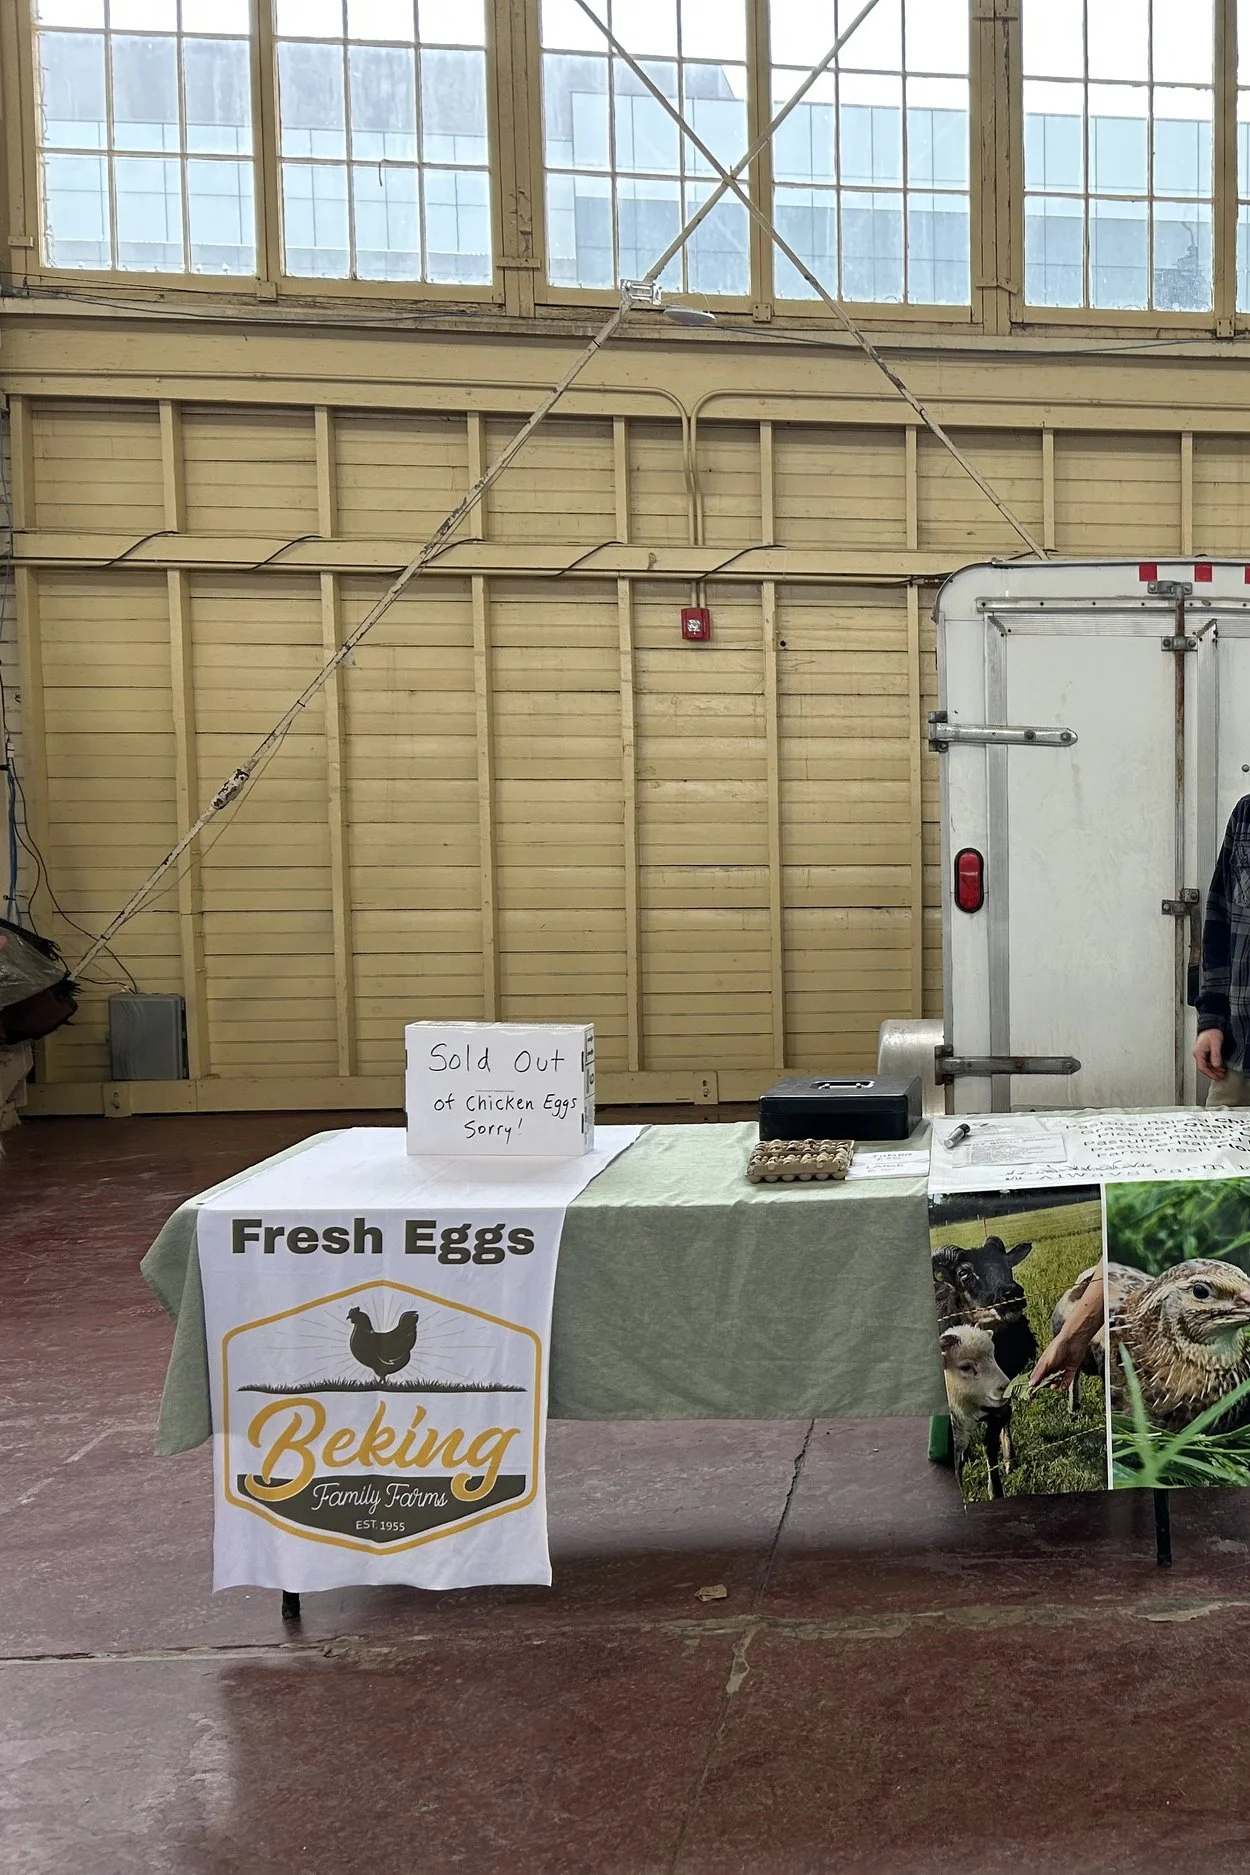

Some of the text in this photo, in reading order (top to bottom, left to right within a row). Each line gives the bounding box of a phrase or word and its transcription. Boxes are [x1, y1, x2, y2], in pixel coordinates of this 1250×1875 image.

[428, 1043, 566, 1073] Sold Out
[433, 1093, 578, 1119] of Chicken Eggs
[464, 1118, 523, 1144] Sorry!
[231, 1217, 535, 1265] Fresh Eggs
[244, 1397, 521, 1502] Beking
[310, 1481, 448, 1515] Family Farms
[355, 1519, 406, 1532] EST. 1955
